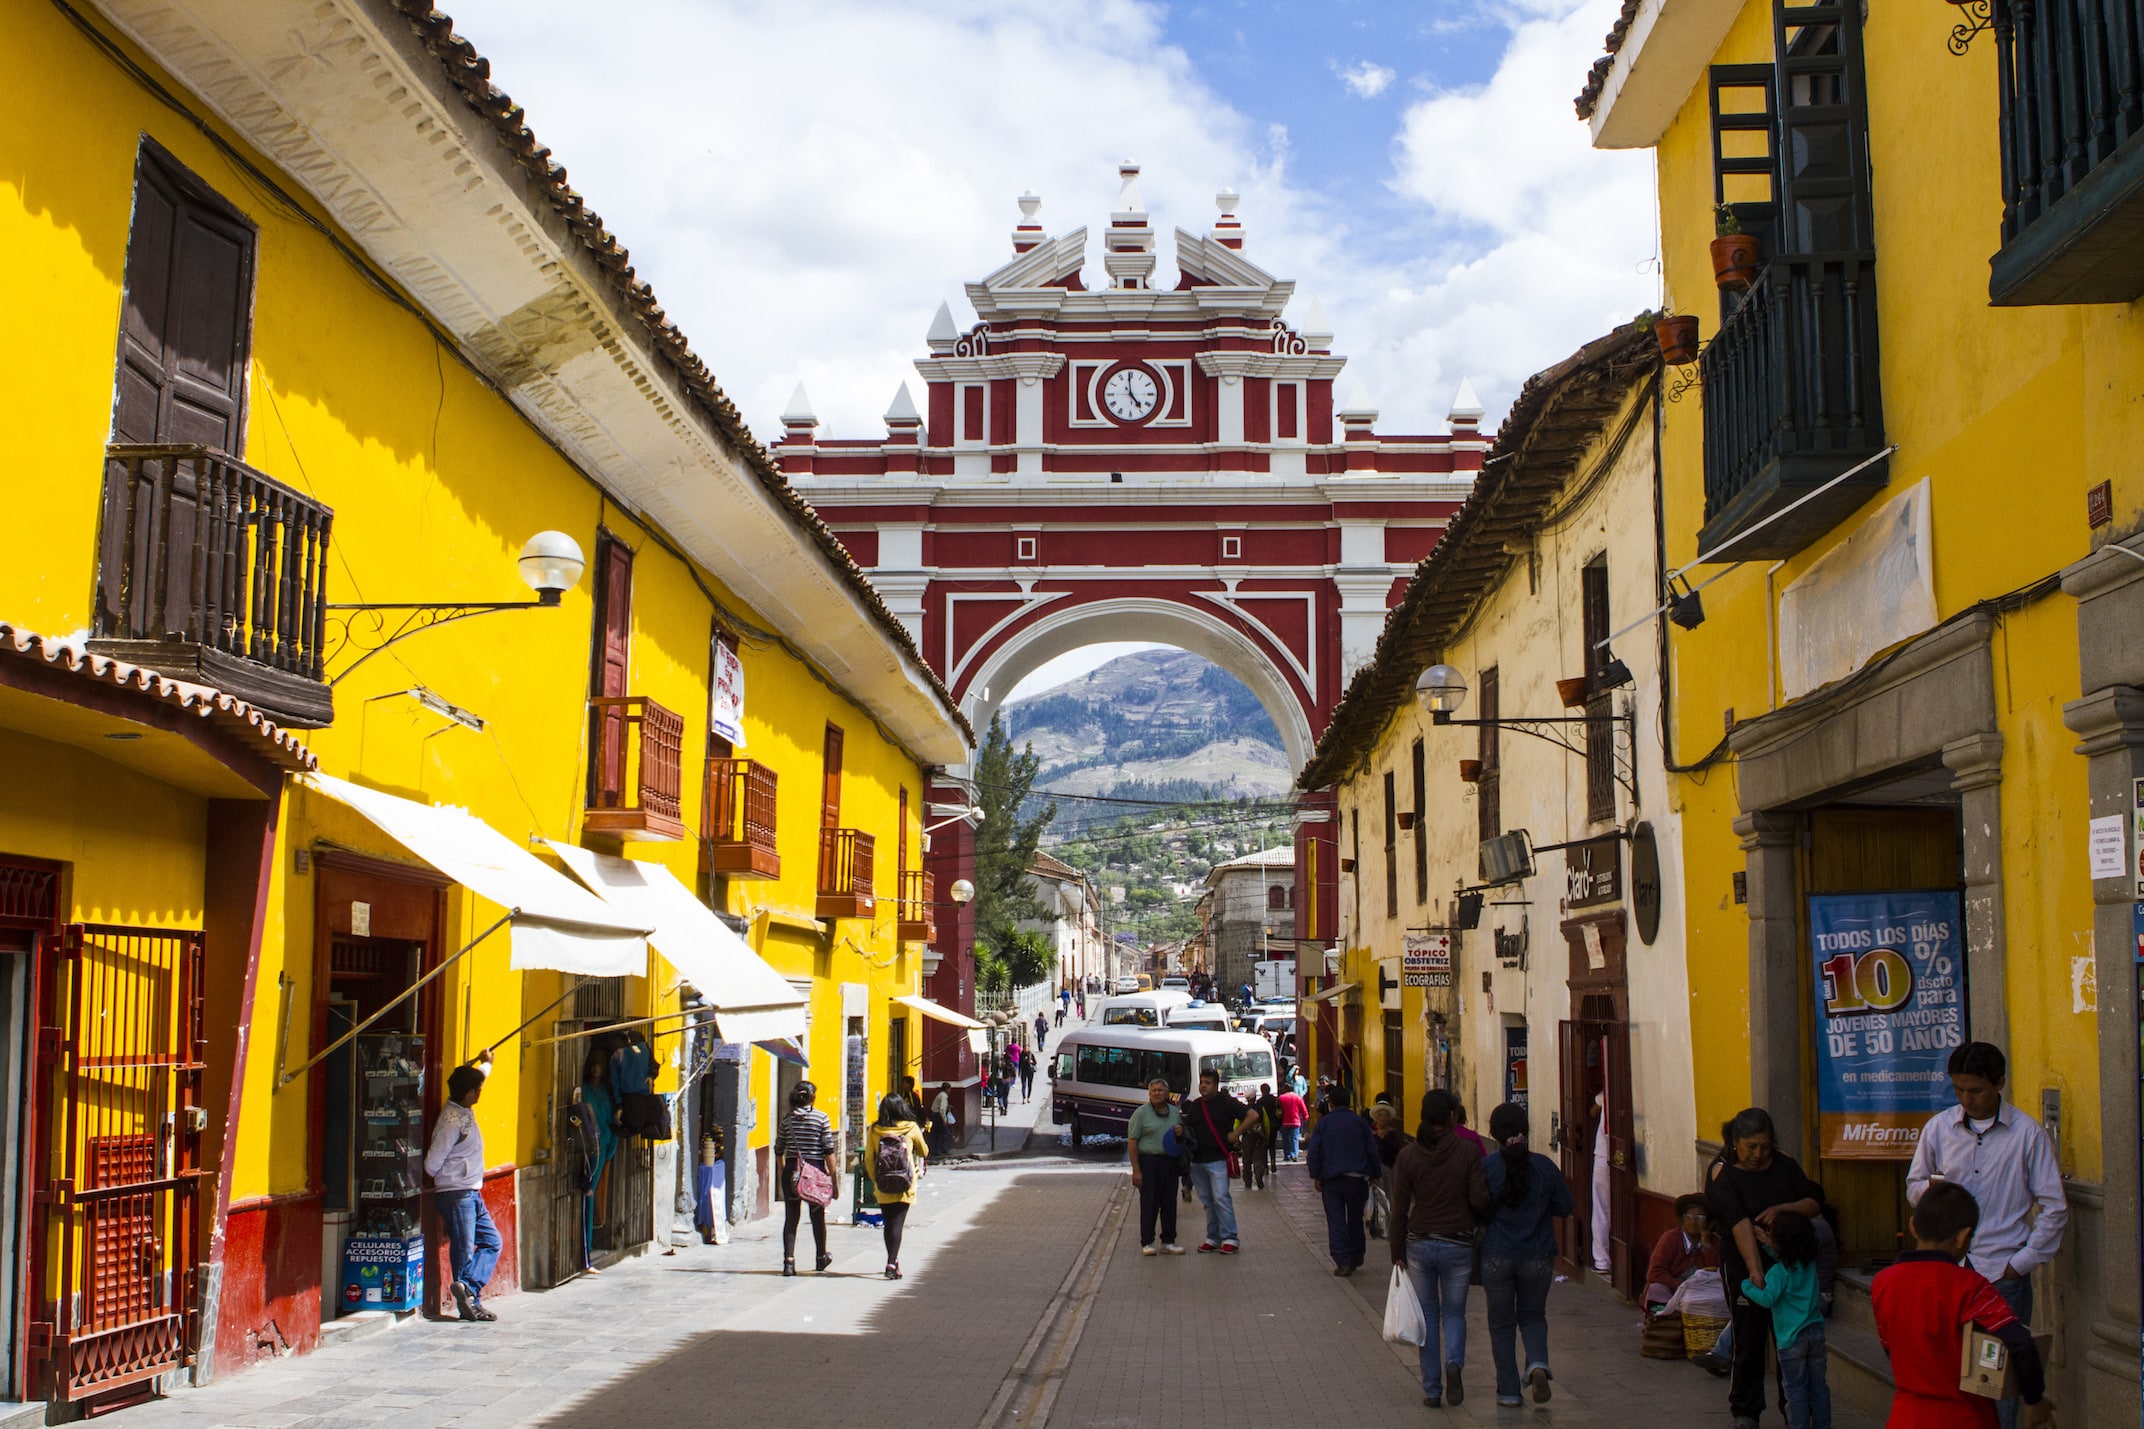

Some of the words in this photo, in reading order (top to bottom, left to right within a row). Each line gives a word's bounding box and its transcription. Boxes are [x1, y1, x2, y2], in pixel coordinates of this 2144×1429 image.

[1567, 863, 1590, 902] Claro
[1817, 930, 1872, 951] TODOS
[1876, 927, 1907, 945] LOS
[1912, 920, 1950, 943] DÍAS
[1404, 957, 1449, 965] OBSTETRIZ
[1408, 947, 1446, 957] TÓPICO
[1404, 973, 1450, 986] ECOGRAFÍAS
[1822, 947, 1912, 1014] 10
[1918, 976, 1953, 990] dscto
[1917, 988, 1957, 1009] para
[1826, 1014, 1888, 1035] JÓVENES
[1891, 1008, 1958, 1028] MAYORES
[1828, 1033, 1859, 1058] DE
[1865, 1030, 1894, 1055] 50
[1901, 1024, 1962, 1051] AÑOS
[1842, 1072, 1857, 1083] en
[1861, 1070, 1945, 1083] medicamentos
[1842, 1122, 1920, 1141] Mifarma
